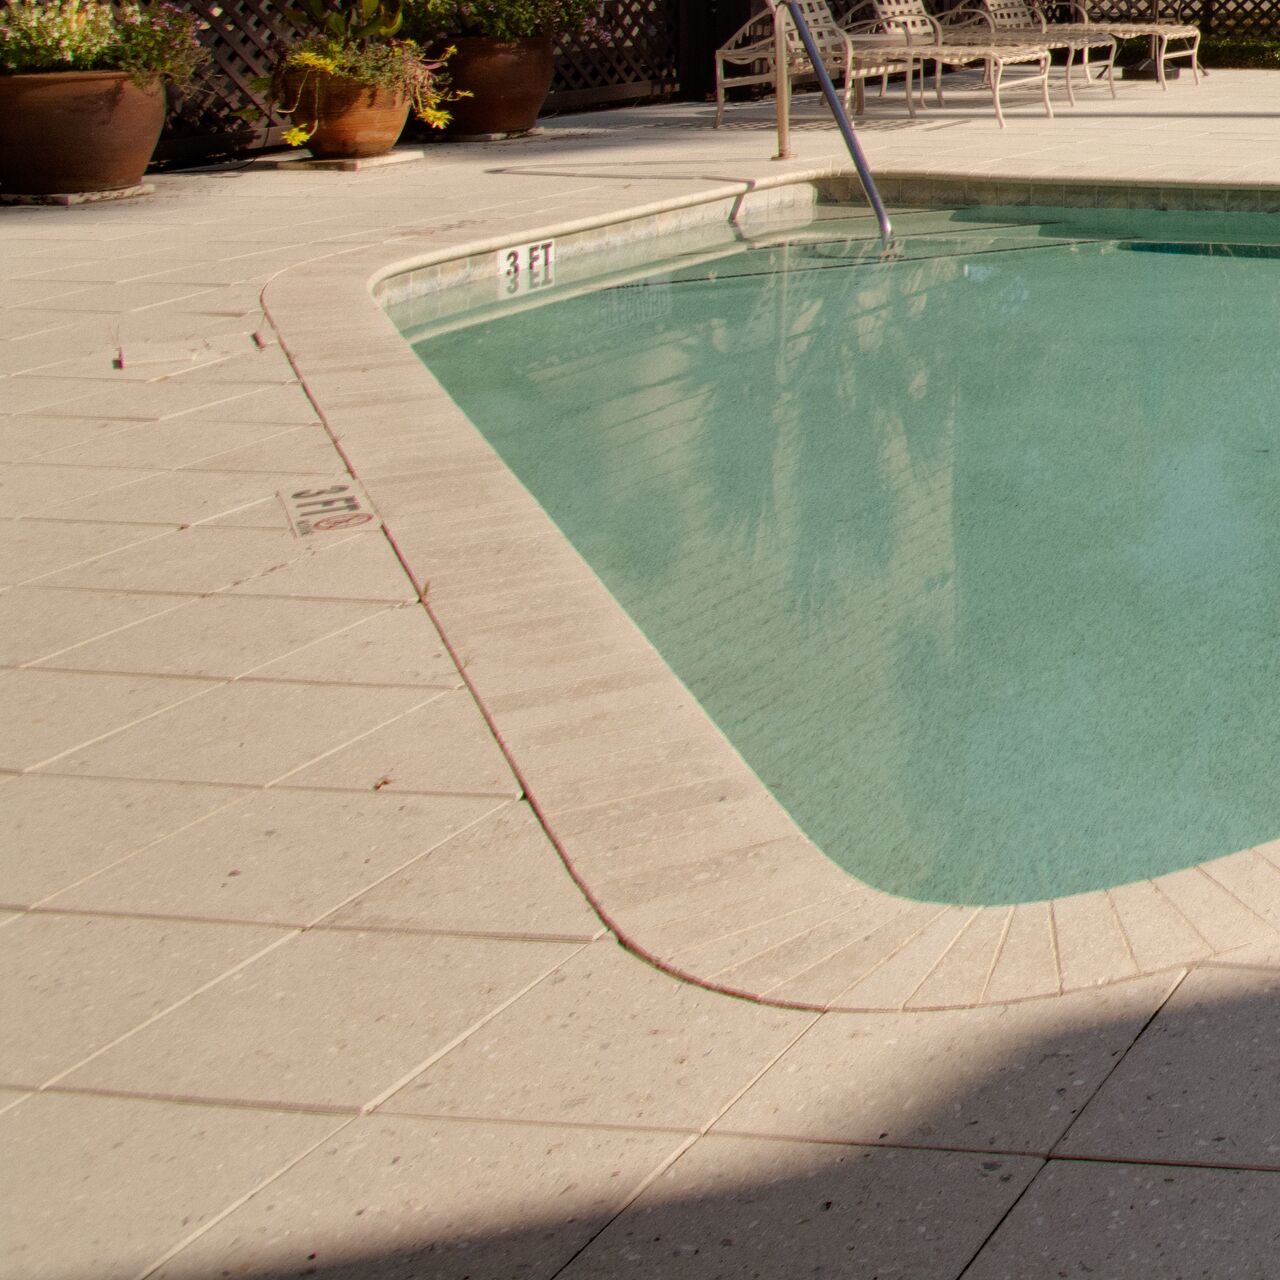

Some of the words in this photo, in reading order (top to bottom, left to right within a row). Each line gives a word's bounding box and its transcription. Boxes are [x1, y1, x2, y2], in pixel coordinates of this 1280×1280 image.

[506, 250, 519, 276] 3
[529, 241, 553, 270] FT
[291, 484, 351, 499] 3
[296, 495, 361, 517] FT
